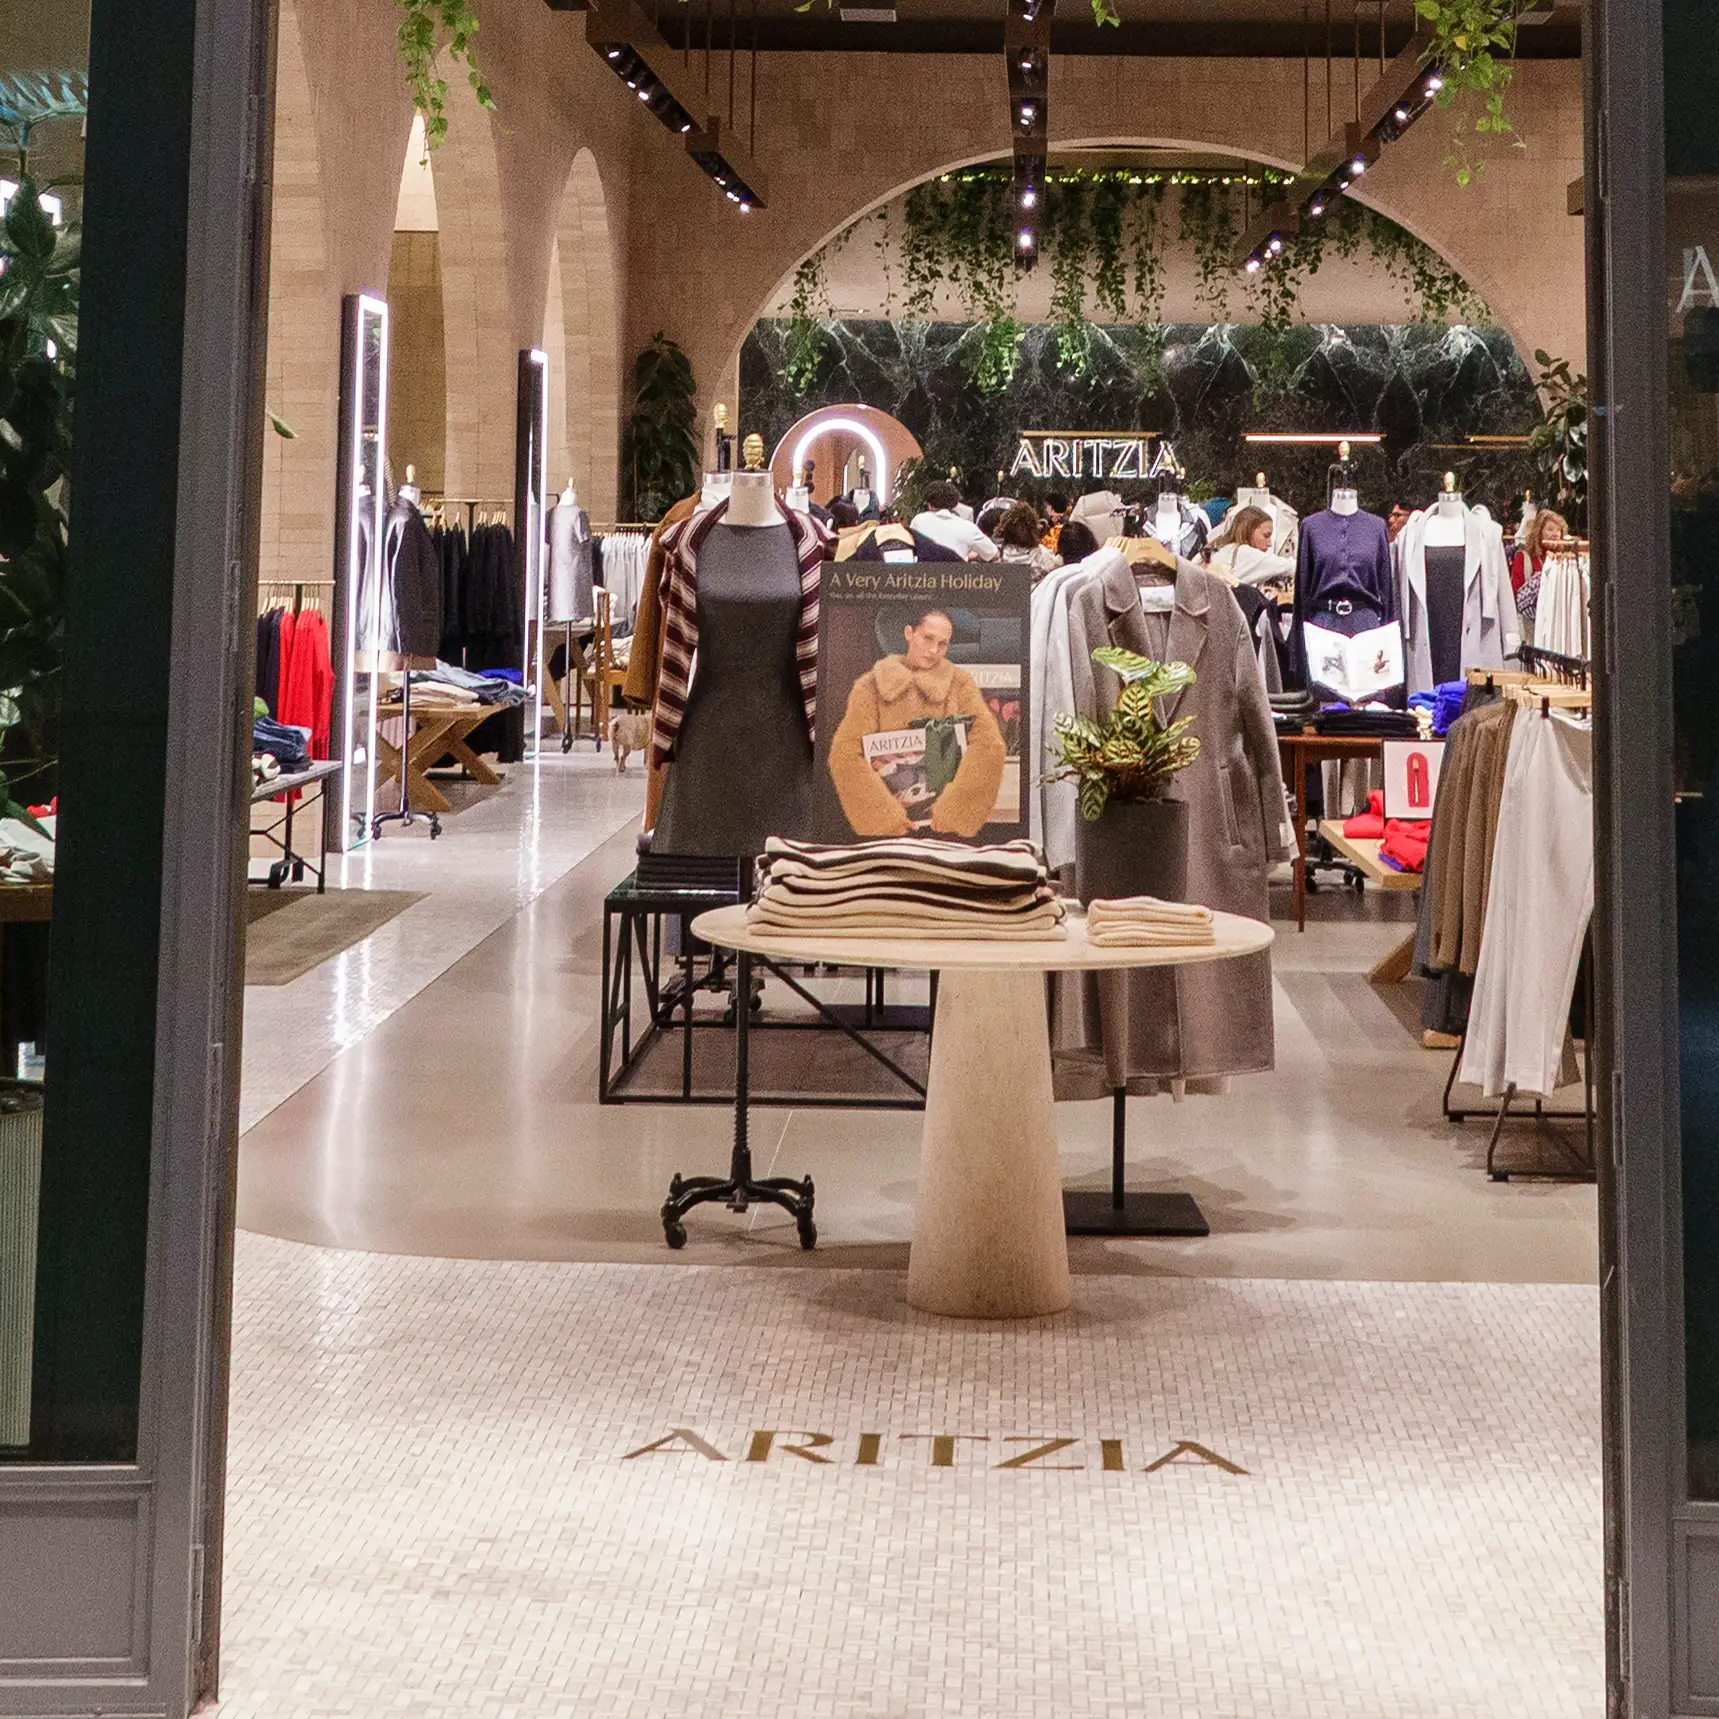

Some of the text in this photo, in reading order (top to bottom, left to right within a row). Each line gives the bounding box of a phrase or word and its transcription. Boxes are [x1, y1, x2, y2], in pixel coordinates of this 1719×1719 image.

[1009, 438, 1184, 480] ARITZIA
[829, 571, 1003, 592] A Very Aritzia Holiday
[869, 735, 923, 753] ARITZIA
[620, 1426, 1252, 1476] ARITZIA
